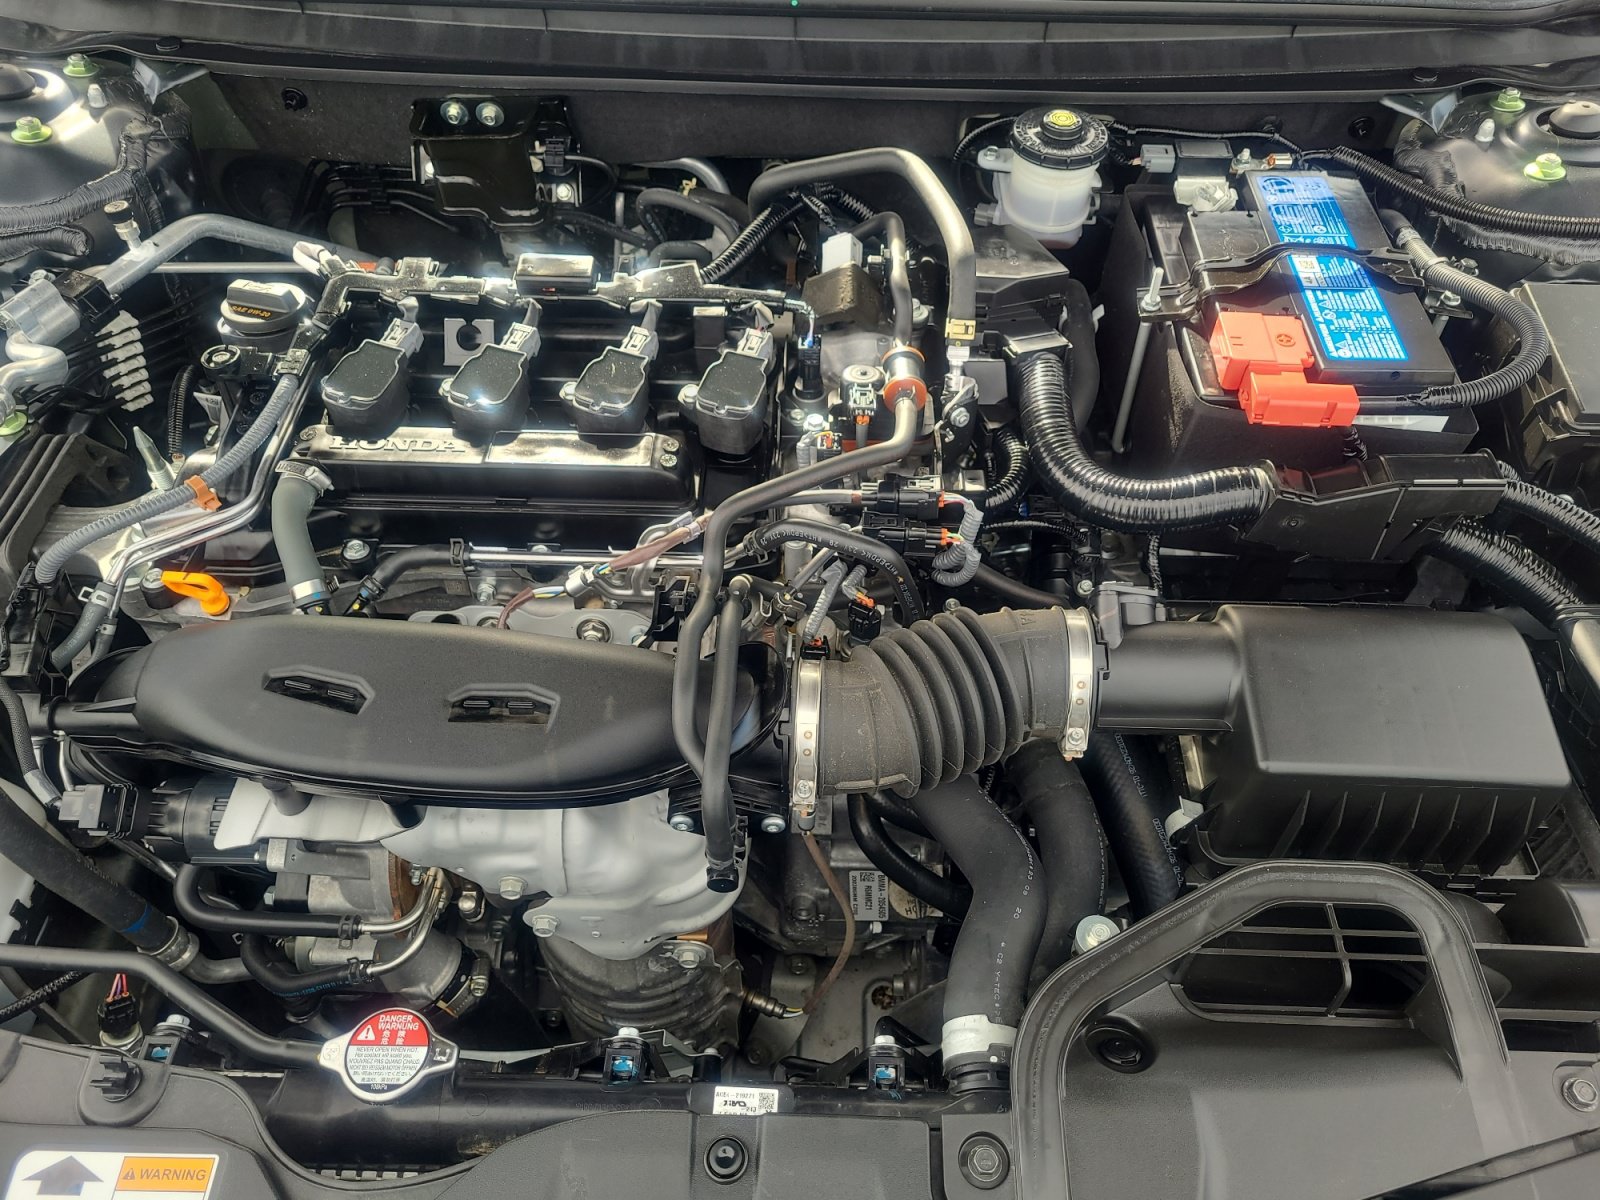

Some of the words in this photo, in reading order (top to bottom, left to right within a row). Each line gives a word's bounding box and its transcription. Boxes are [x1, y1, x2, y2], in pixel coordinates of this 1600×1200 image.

[232, 305, 248, 314] SAE
[329, 436, 465, 452] HONDA
[1014, 907, 1022, 919] 20
[378, 1022, 418, 1030] WARNUNG
[140, 1168, 206, 1181] WARNING
